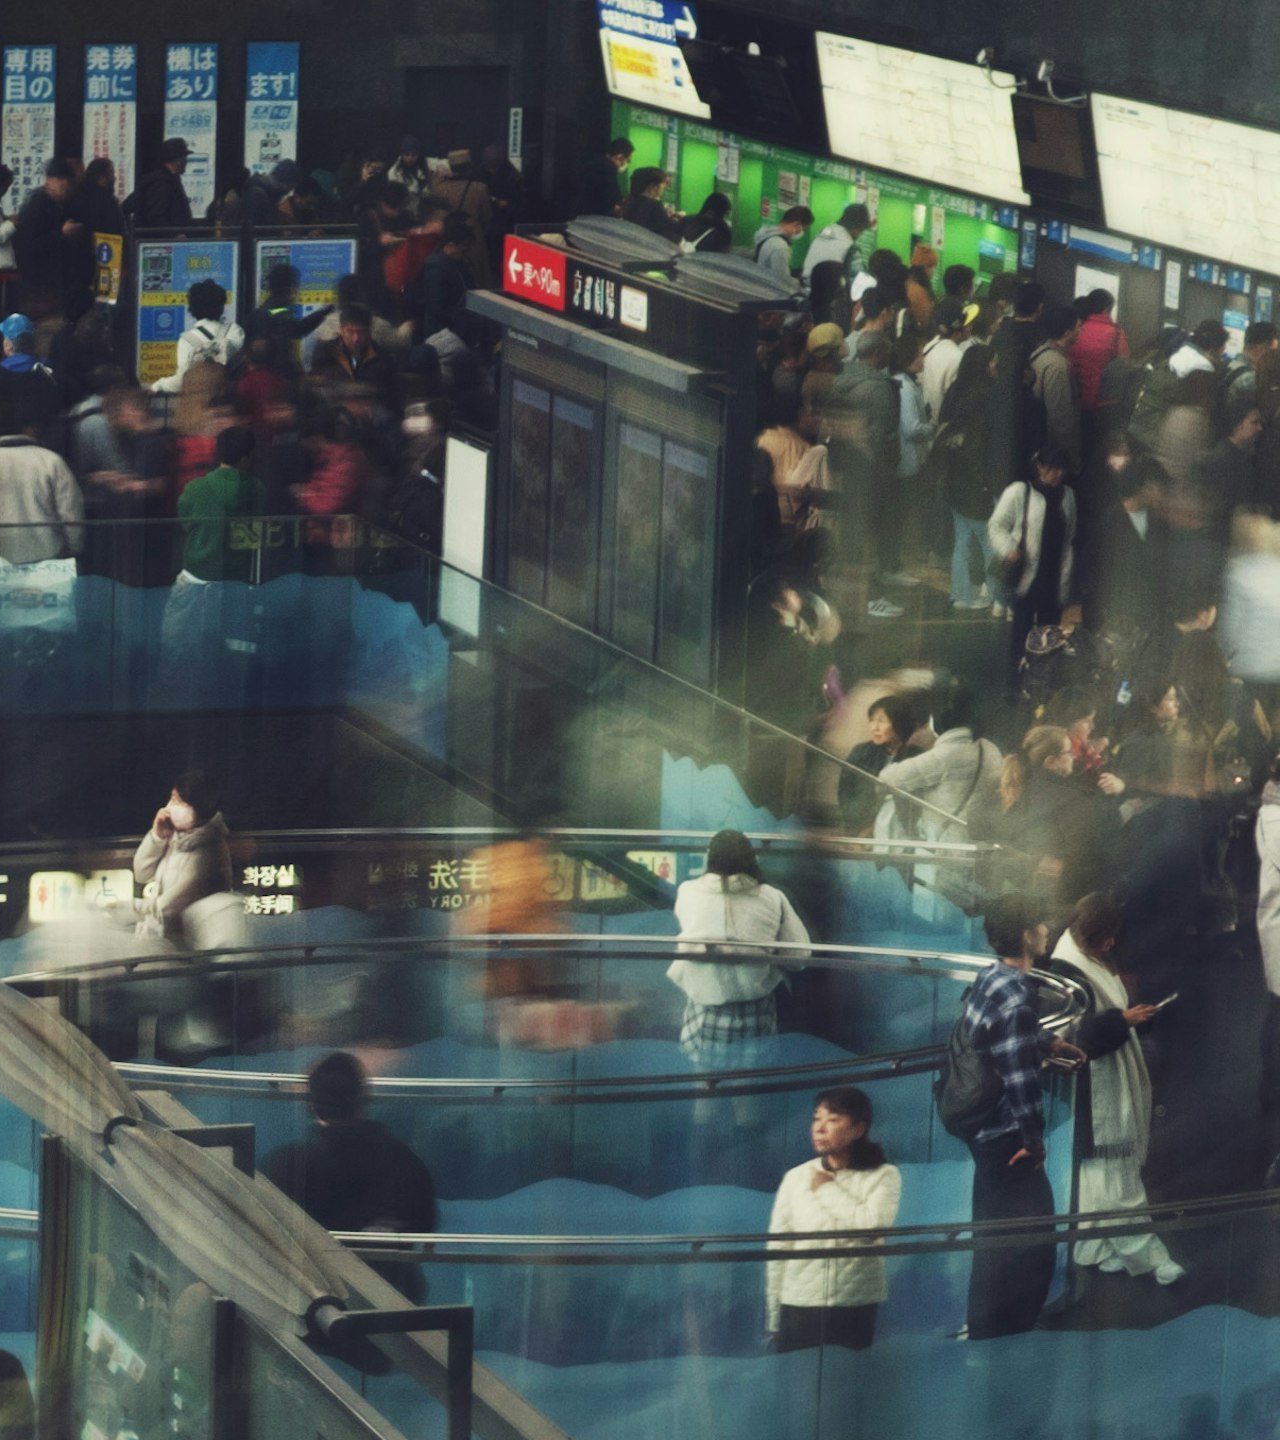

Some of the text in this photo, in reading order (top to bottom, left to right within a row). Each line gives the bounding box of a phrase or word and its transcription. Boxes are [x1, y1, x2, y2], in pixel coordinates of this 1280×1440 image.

[5, 48, 53, 73] 専用
[87, 46, 136, 71] 発券
[167, 47, 216, 72] 機は
[5, 75, 53, 100] 目の
[87, 74, 133, 99] 前に
[167, 75, 215, 99] あり
[243, 864, 296, 888] 화장실
